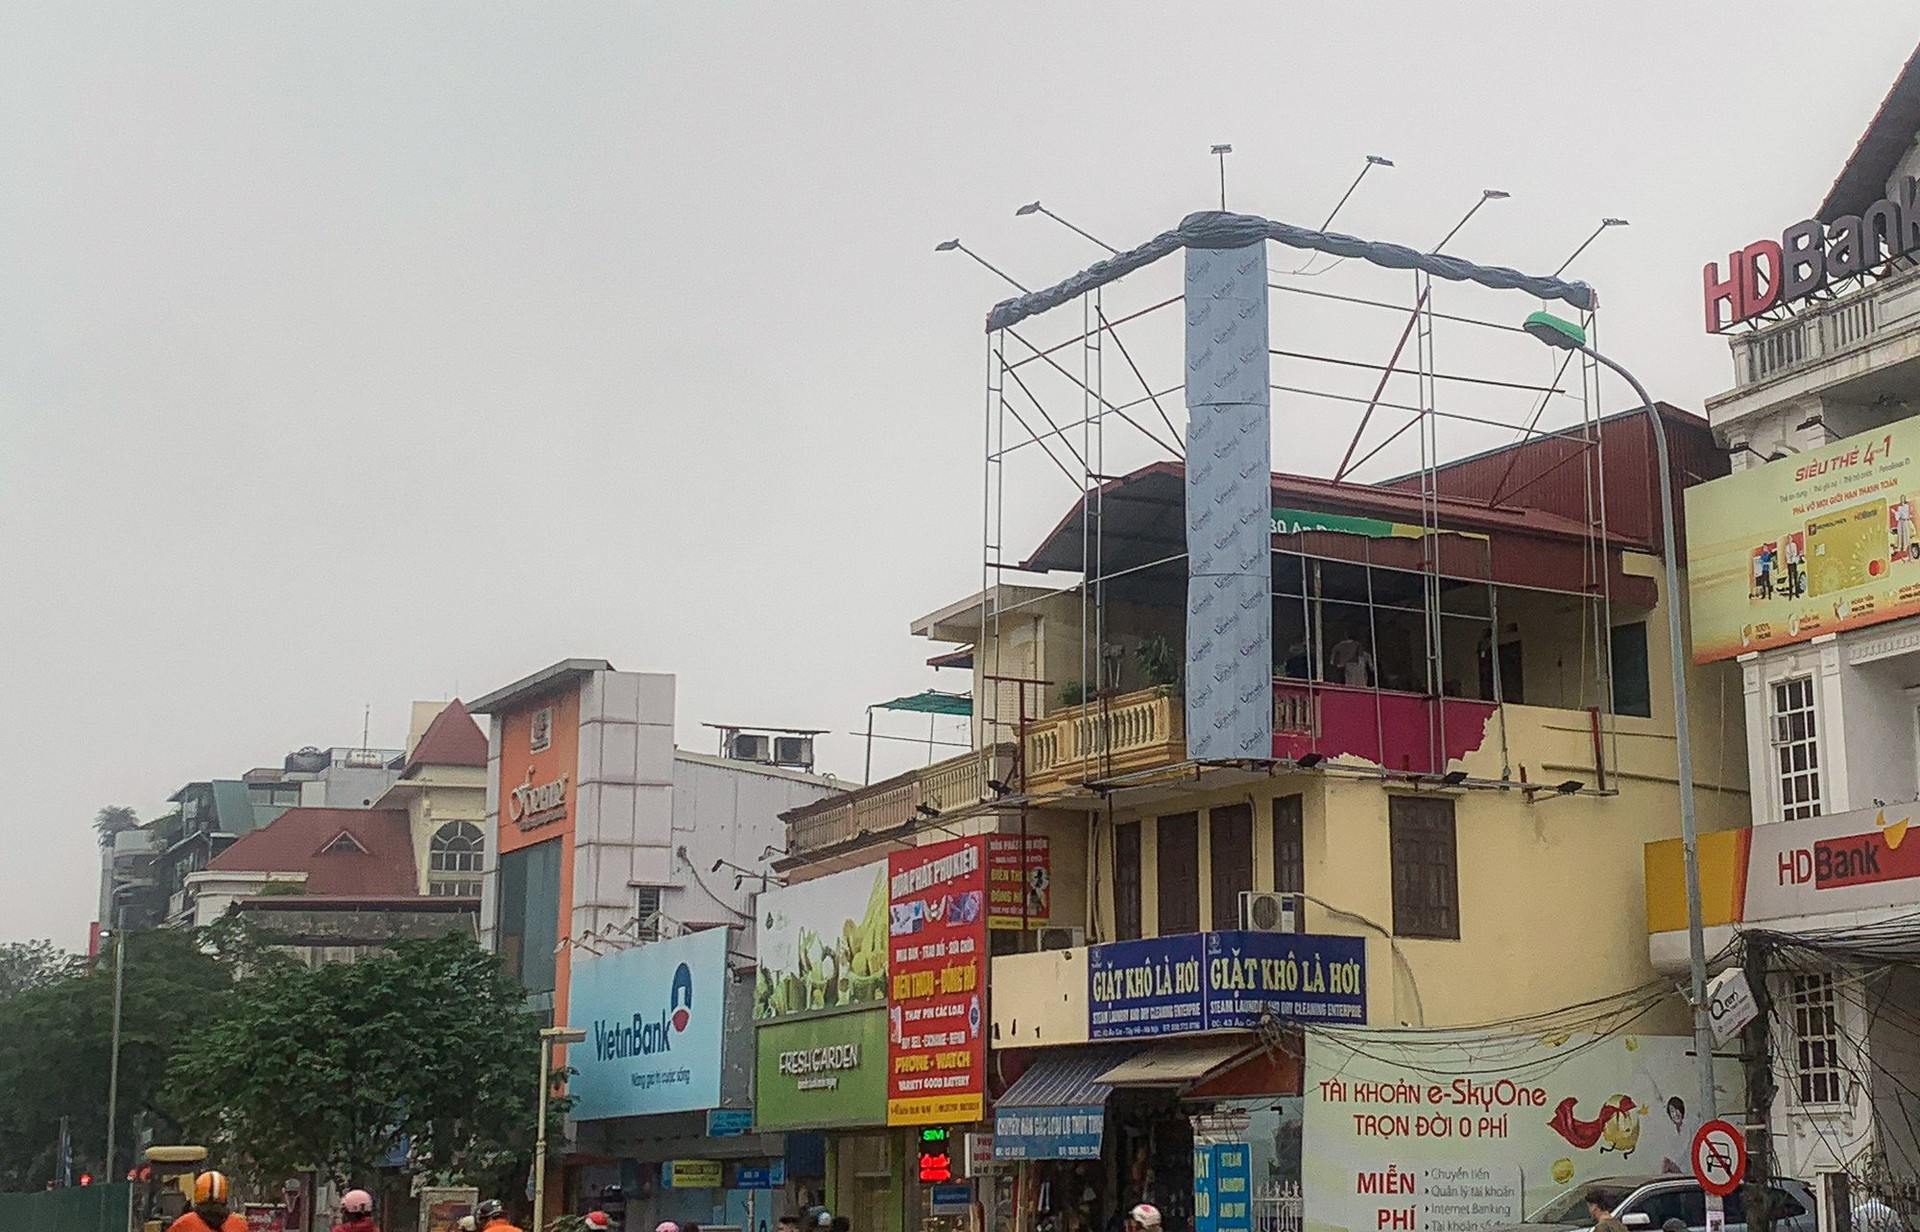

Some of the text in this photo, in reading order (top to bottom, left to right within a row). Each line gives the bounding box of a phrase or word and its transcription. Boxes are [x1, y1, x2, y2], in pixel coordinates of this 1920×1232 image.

[1704, 175, 1920, 334] HDBank
[1777, 840, 1881, 887] HDBank
[1093, 961, 1123, 1010] GIẶT
[1125, 956, 1153, 999] KHÔ
[1155, 954, 1173, 996] LÀ
[1210, 947, 1361, 999] GIẶT KHÔ LÀ HƠI
[594, 1008, 672, 1062] VietinBank
[895, 1051, 971, 1075] PHONE WATCH
[1319, 1077, 1547, 1113] TÀI KHOẢN e-SkyOne
[923, 1129, 945, 1141] SIM
[1353, 1114, 1410, 1140] TRỌN
[1415, 1111, 1452, 1138] ĐỜI
[1478, 1112, 1508, 1139] PHÍ
[1357, 1164, 1490, 1195] MIỄN Chuyển tiền
[1431, 1184, 1458, 1198] Quản
[1460, 1184, 1468, 1199] lý
[1484, 1184, 1515, 1198] khoản
[1377, 1202, 1512, 1232] PHÍ Internet Banking
[1447, 1219, 1478, 1232] khoản
